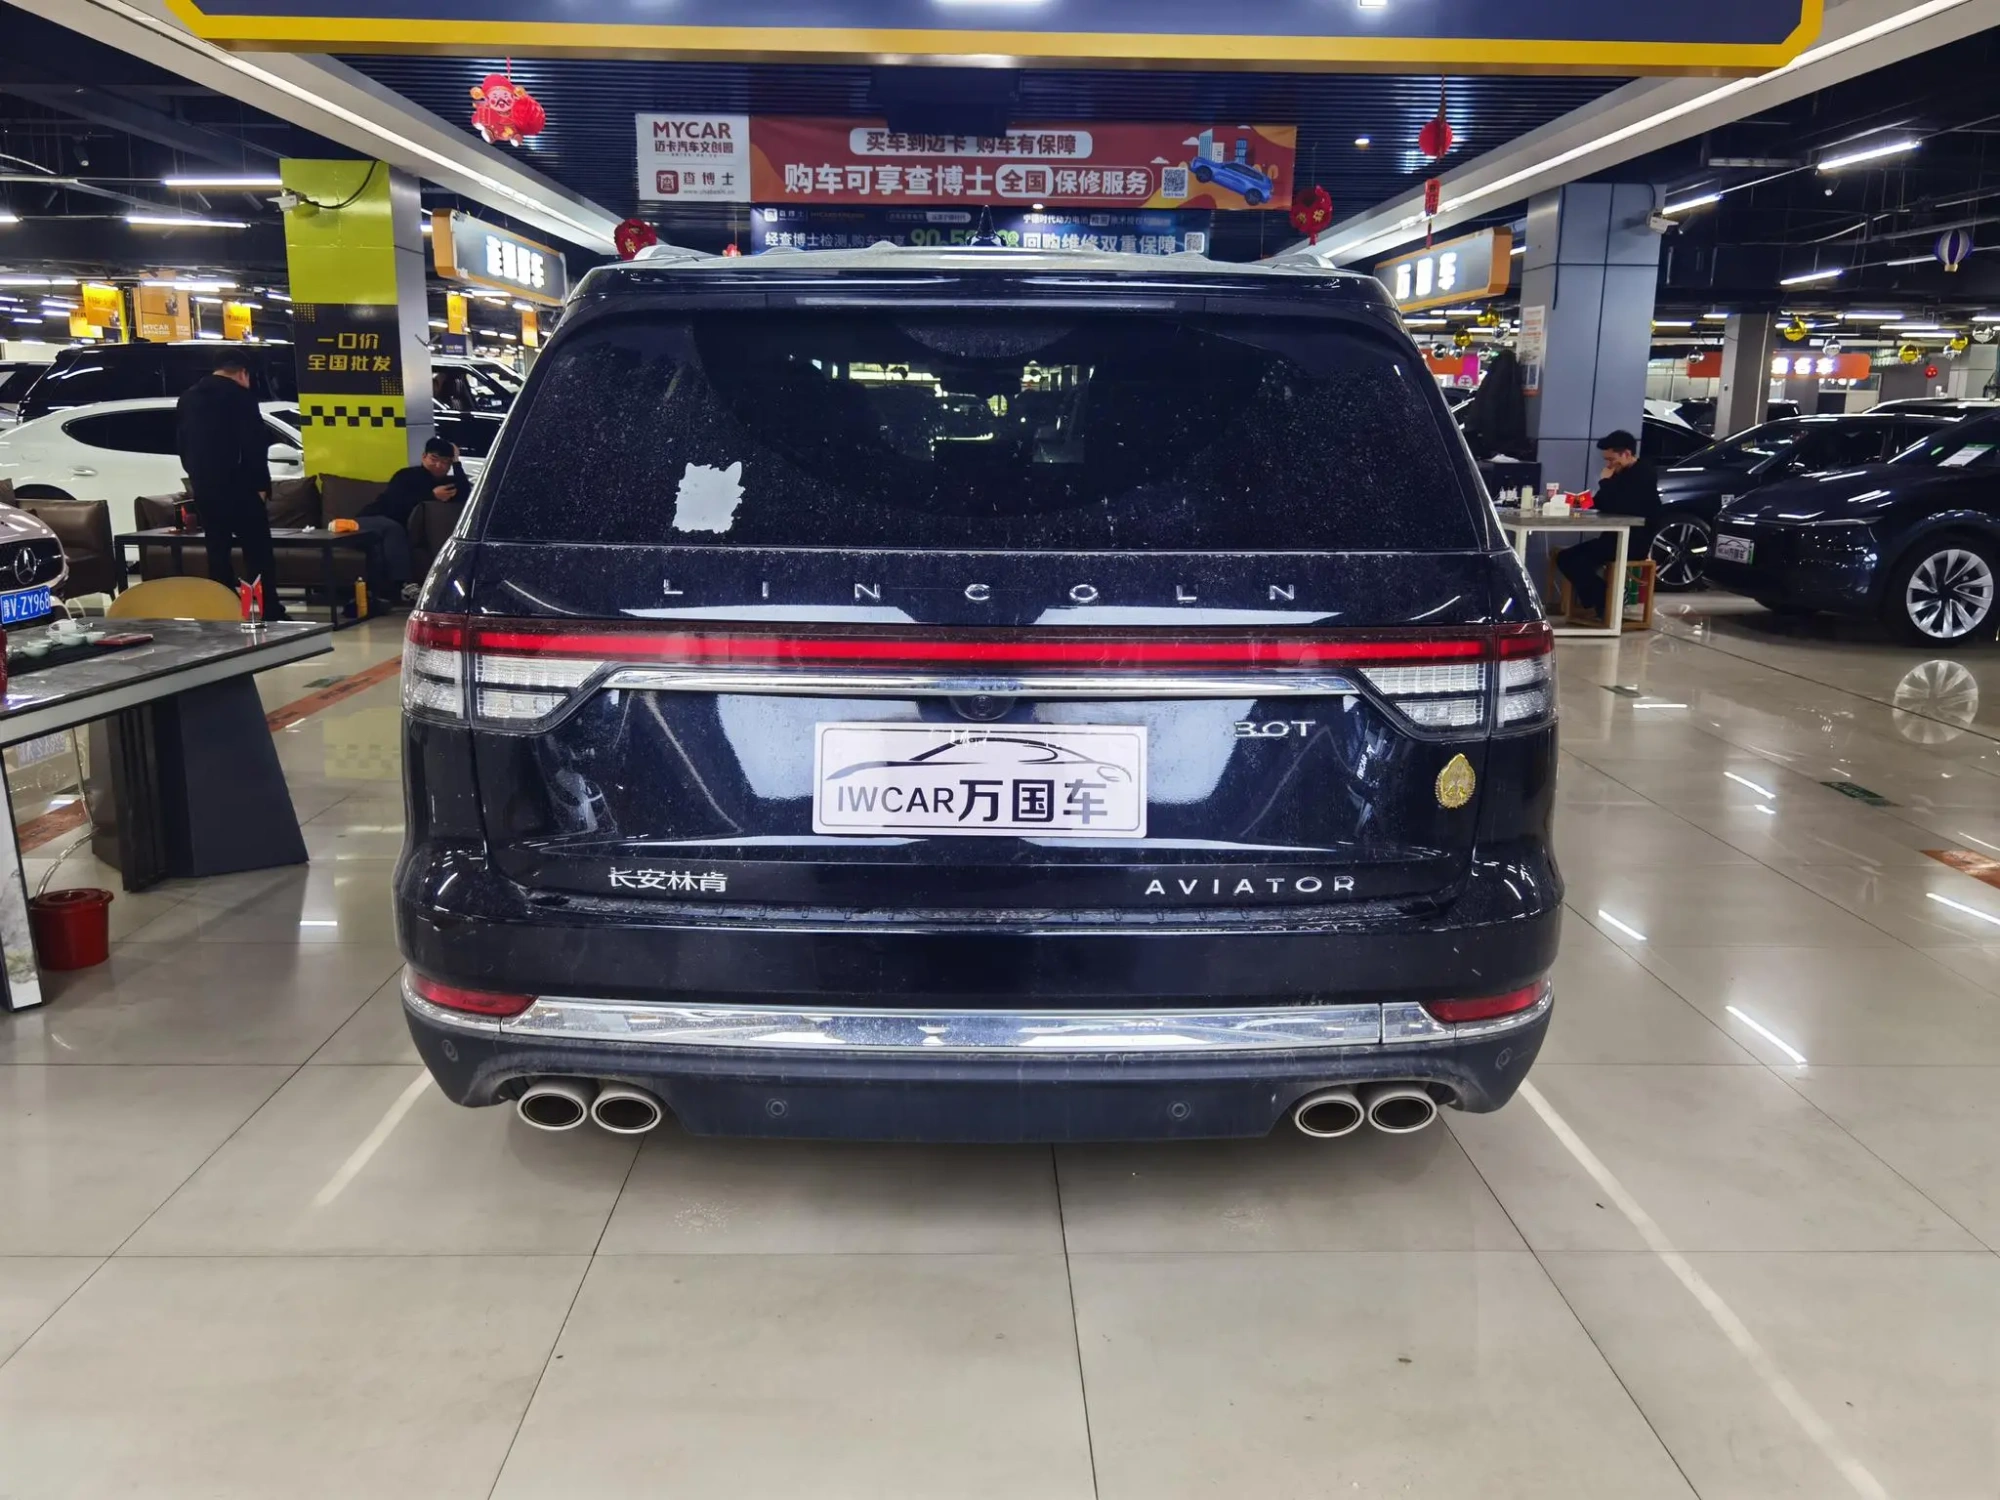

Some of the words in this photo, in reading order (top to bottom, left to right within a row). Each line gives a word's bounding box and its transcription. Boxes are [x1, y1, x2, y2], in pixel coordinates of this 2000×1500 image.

[653, 121, 732, 139] MYCAR
[654, 140, 734, 154] 迈卡汽车文创园
[867, 131, 967, 153] 买车到迈卡
[976, 133, 1077, 155] 购车有保障
[683, 171, 735, 186] 查博士
[784, 163, 1149, 197] 购车可享查博士全国保修服务
[317, 333, 379, 349] 一口价
[307, 354, 391, 371] 全国批发
[663, 579, 1296, 603] LINCOLN
[607, 867, 728, 892] 长安林肯
[1144, 875, 1355, 896] AVIATOR
